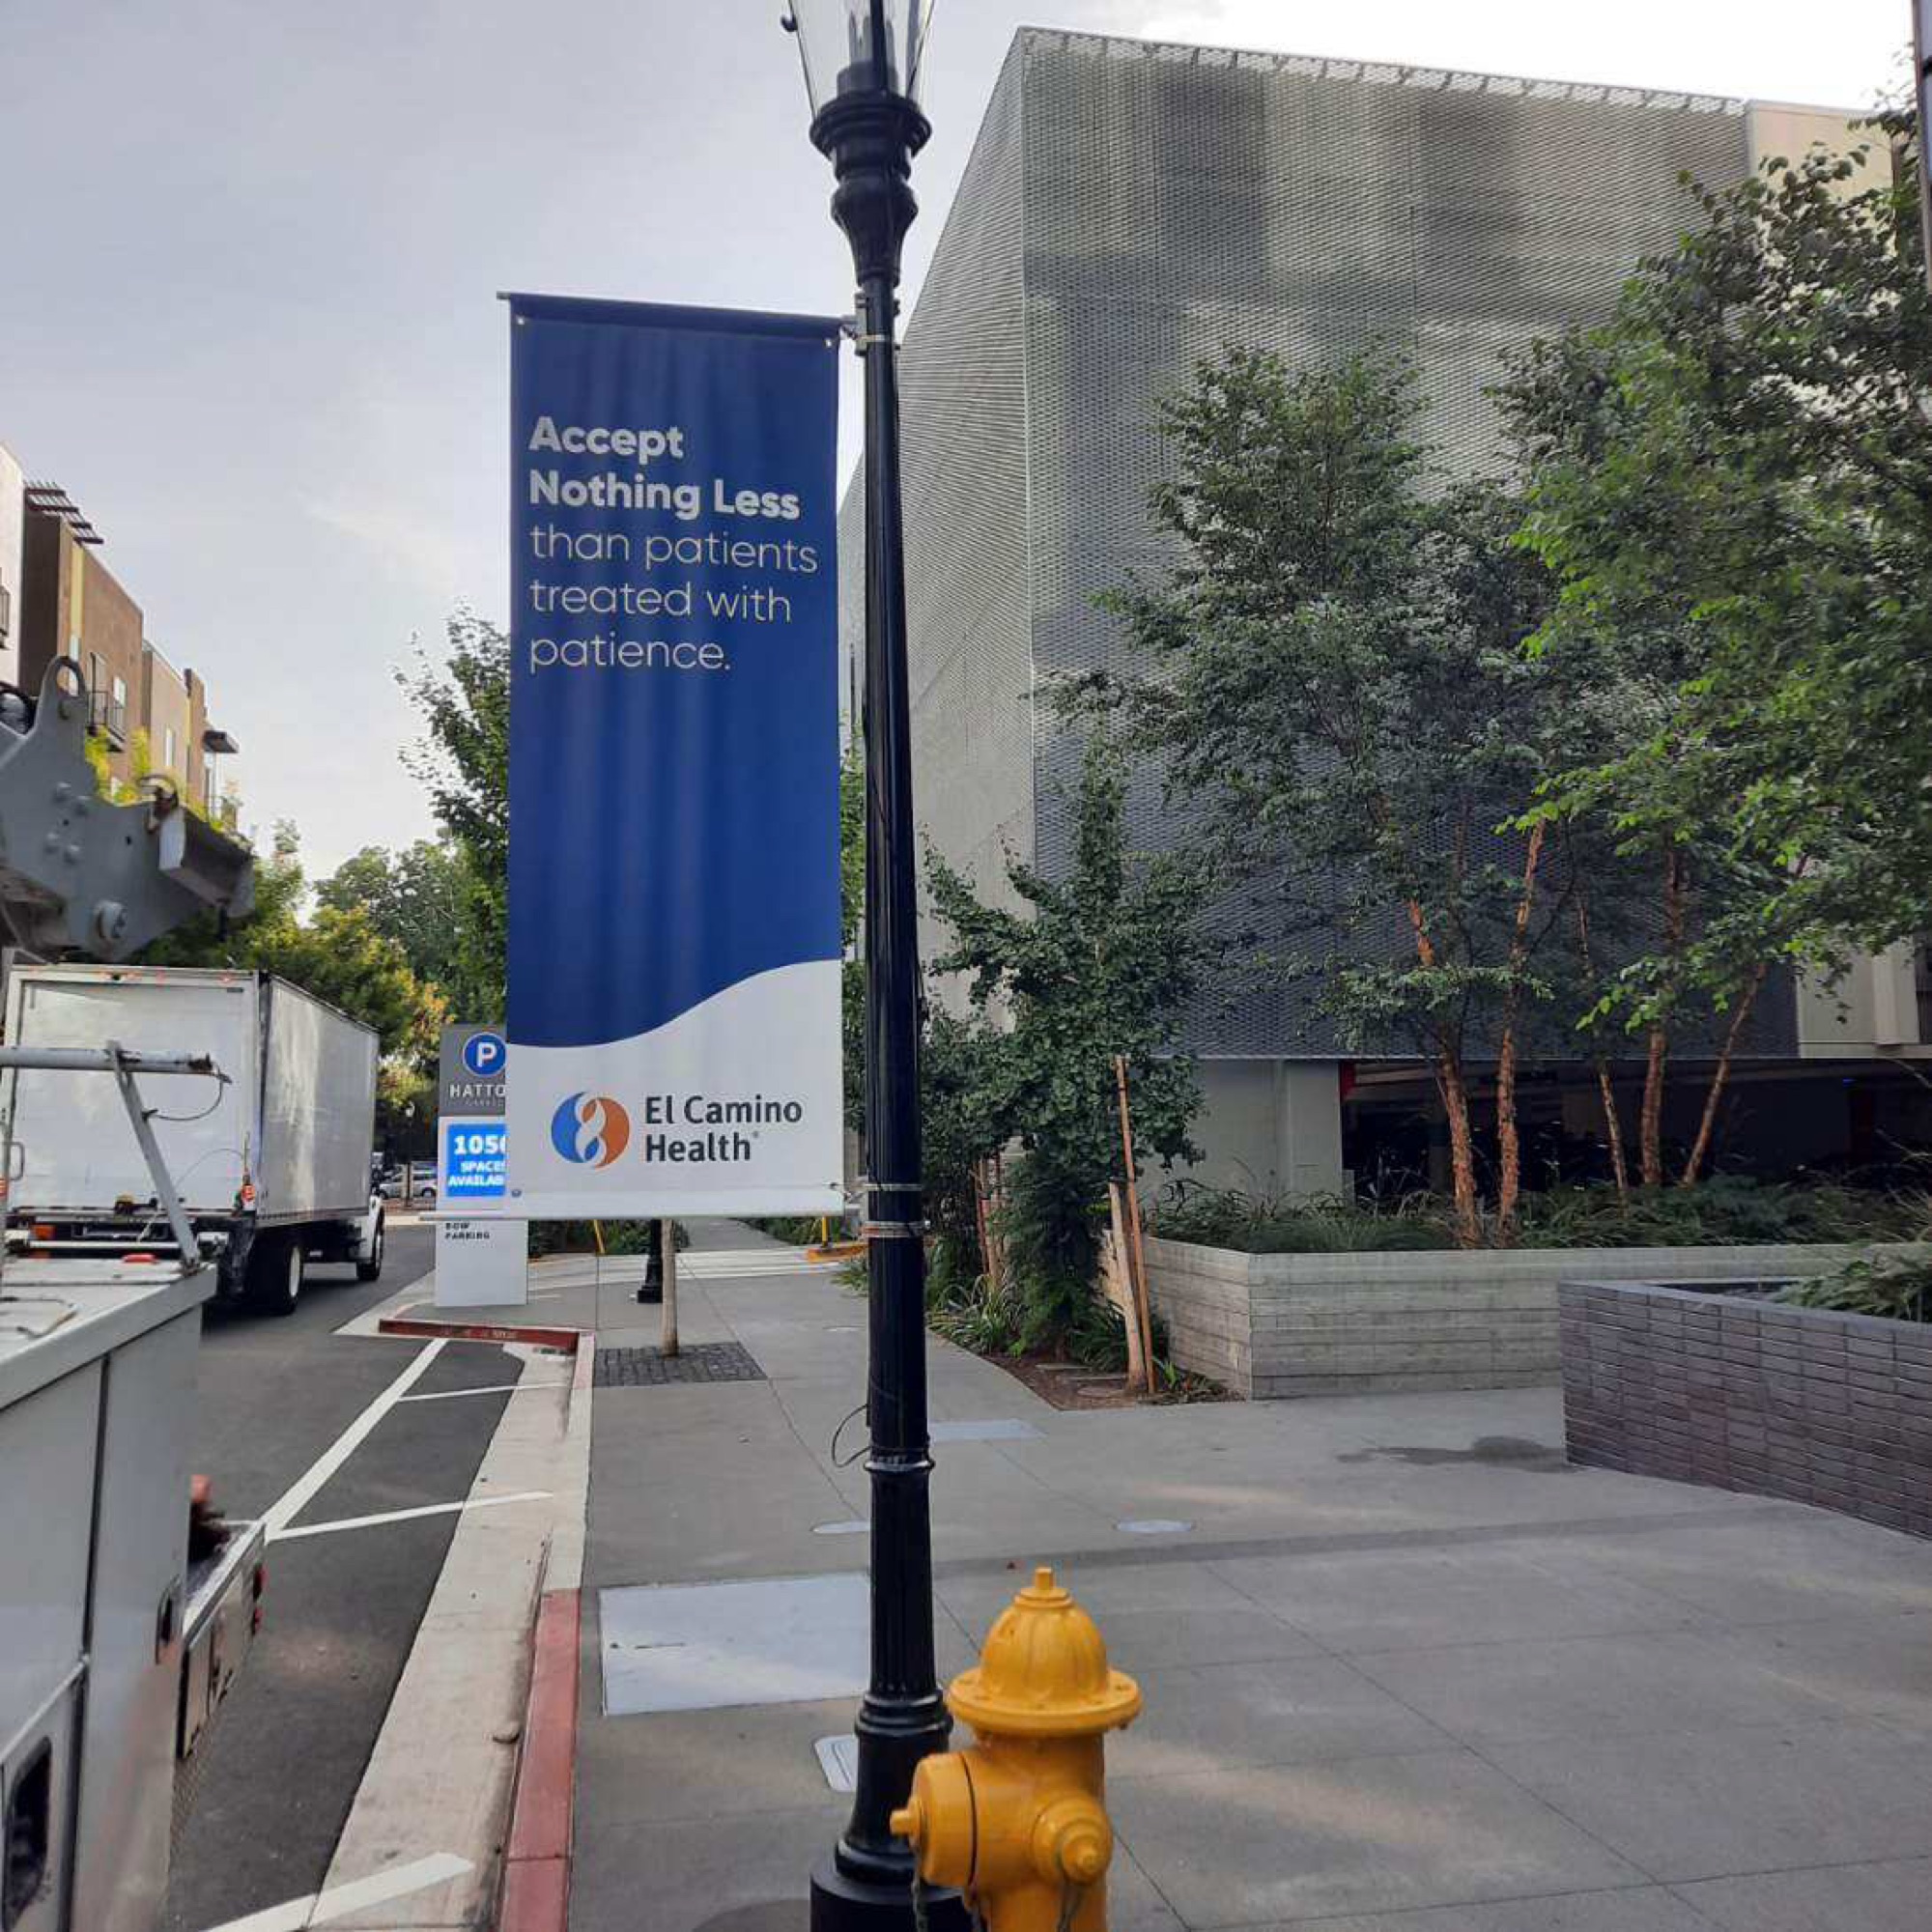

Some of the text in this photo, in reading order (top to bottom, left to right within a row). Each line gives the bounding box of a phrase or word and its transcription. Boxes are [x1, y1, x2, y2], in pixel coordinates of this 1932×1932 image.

[528, 415, 683, 465] Accept
[530, 469, 801, 520] Nothing Less
[529, 524, 818, 572] than patients
[529, 580, 790, 622] treated with
[530, 632, 730, 673] patience.
[476, 1041, 497, 1067] P
[645, 1094, 803, 1123] El Camino
[645, 1131, 751, 1161] Health
[444, 1232, 490, 1240] PARKING
